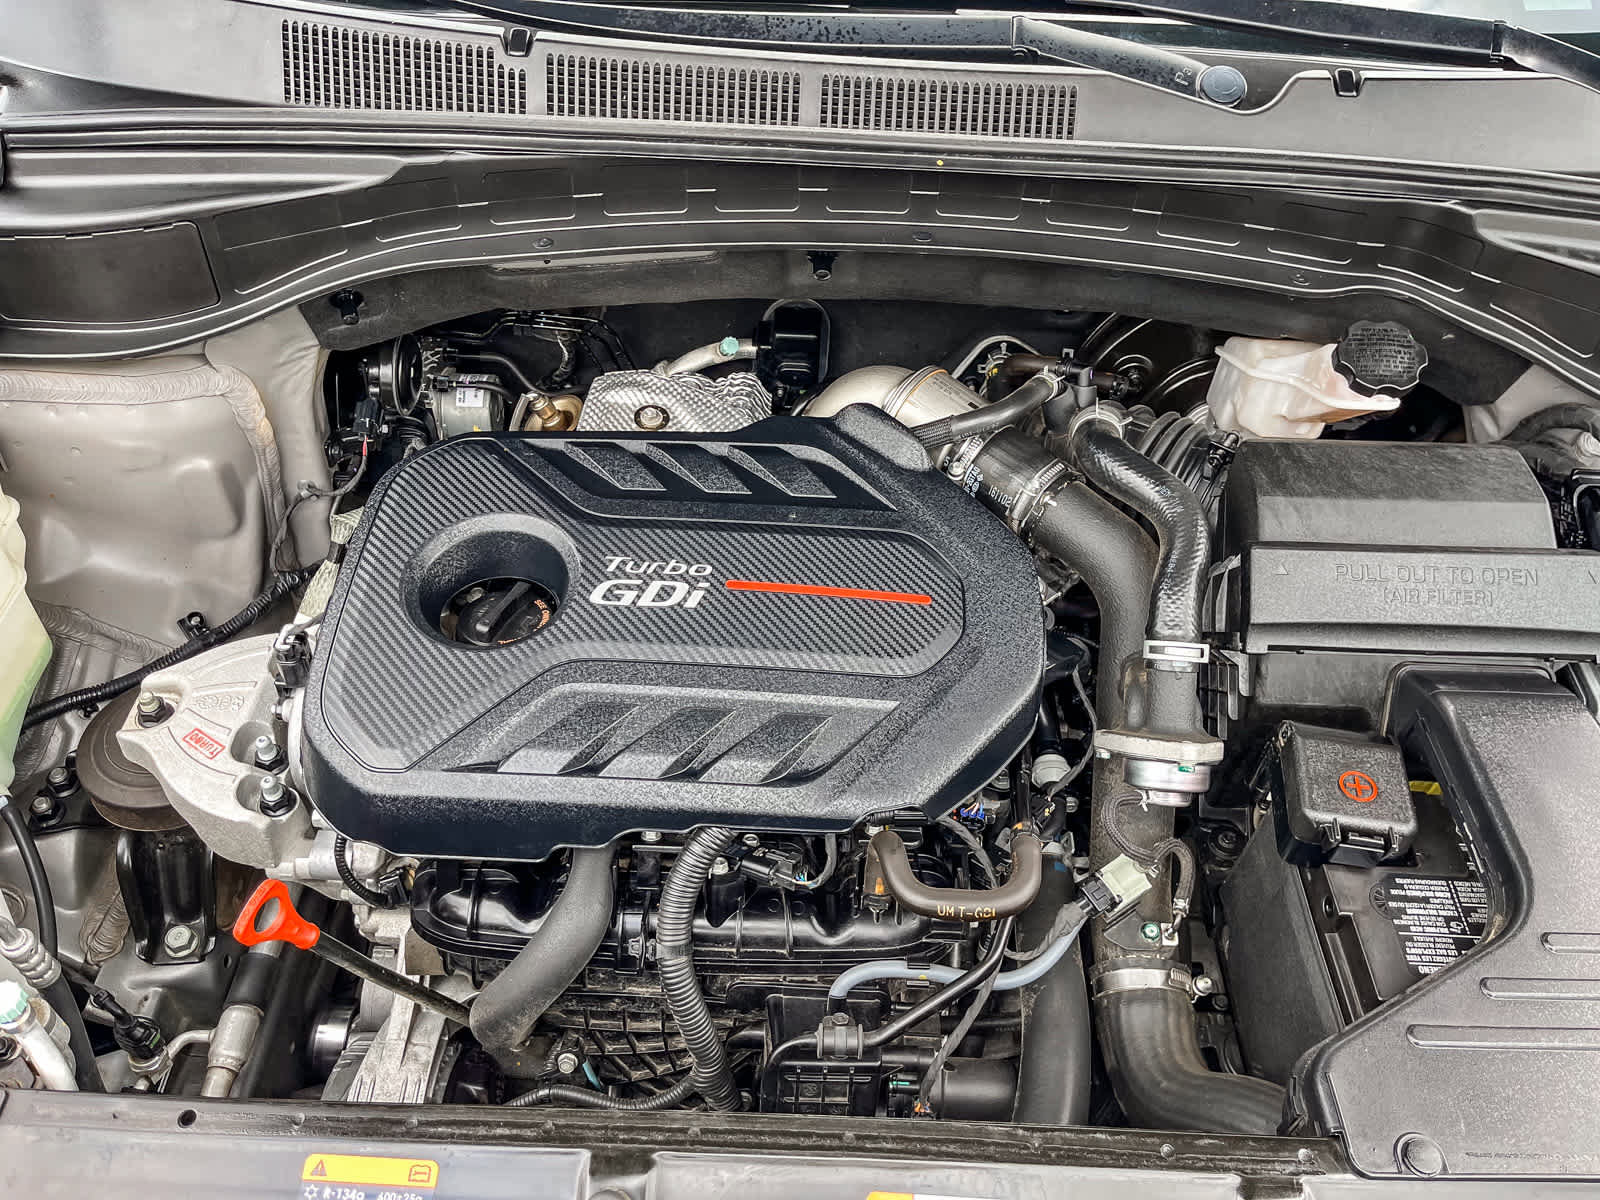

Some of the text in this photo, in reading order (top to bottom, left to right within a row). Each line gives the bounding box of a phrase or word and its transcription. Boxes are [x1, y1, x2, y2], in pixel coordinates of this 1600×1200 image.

[605, 556, 713, 576] Turbo
[1335, 563, 1538, 586] PULL OUT TO OPEN
[589, 579, 711, 608] GDi
[1383, 587, 1494, 607] (AIR FILTER)
[189, 733, 219, 756] TURBO
[937, 904, 955, 917] UM
